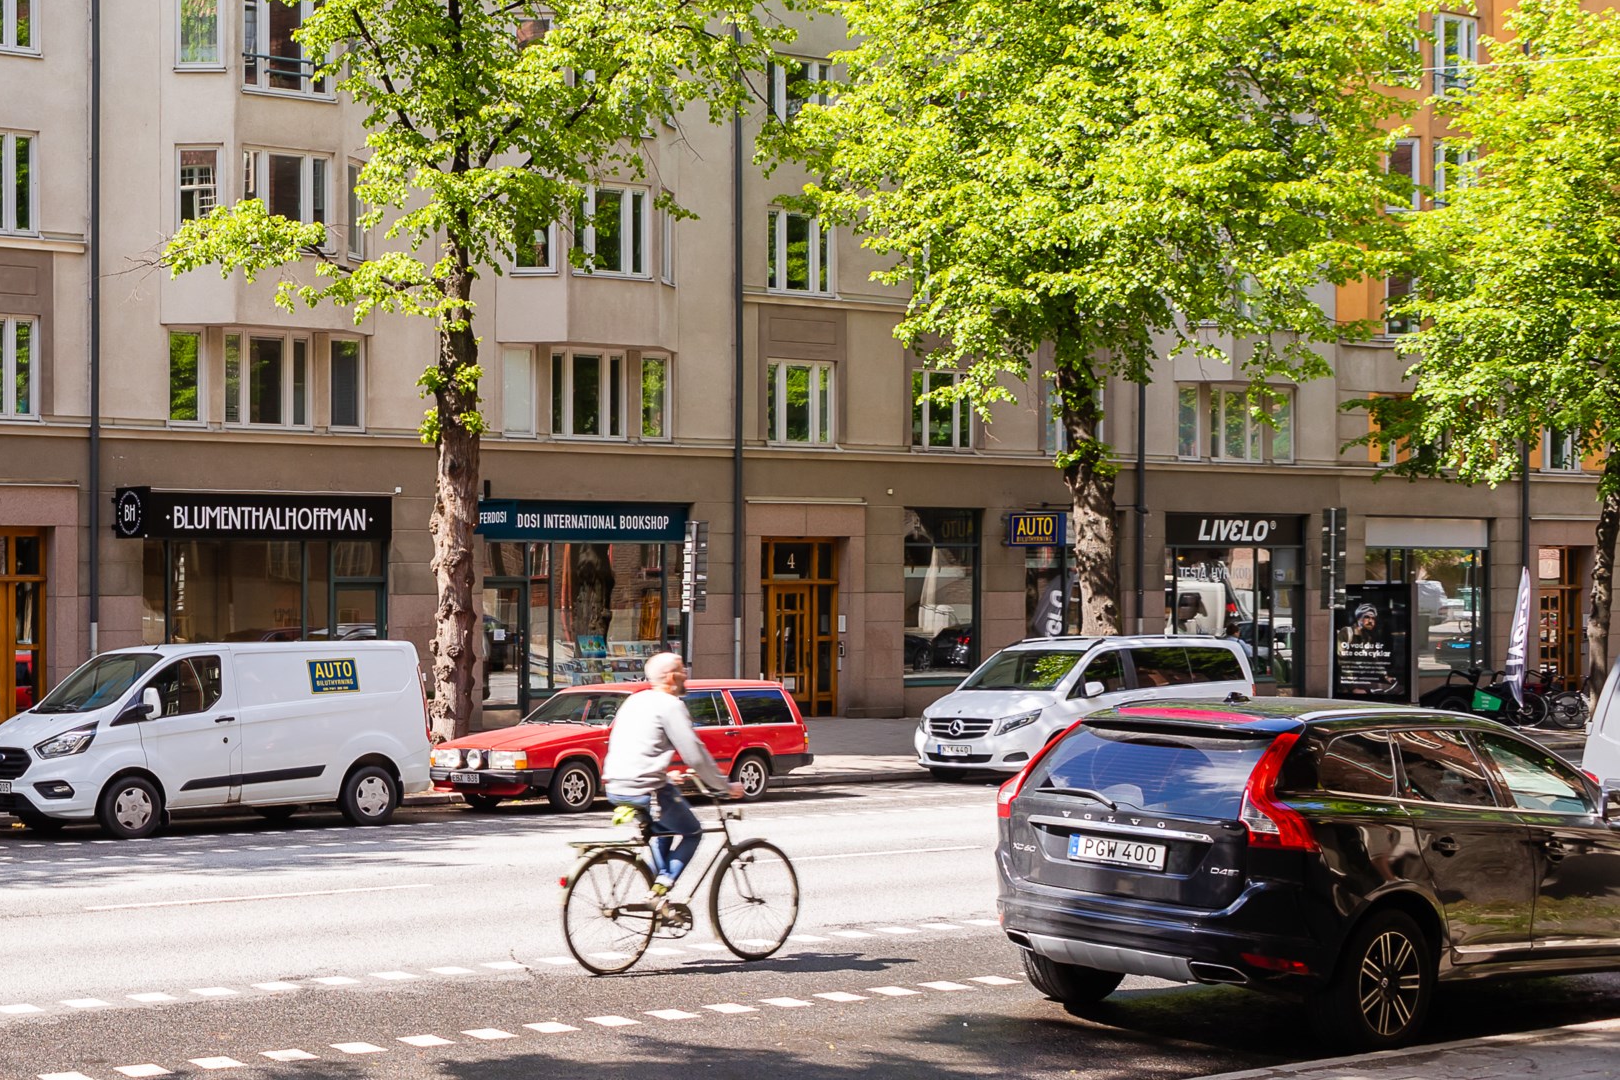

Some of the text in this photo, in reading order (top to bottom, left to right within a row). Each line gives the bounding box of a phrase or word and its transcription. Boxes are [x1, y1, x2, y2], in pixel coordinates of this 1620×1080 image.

[124, 504, 136, 521] BH
[479, 511, 507, 524] FERDOSI
[517, 513, 670, 530] DOSI INTERNATIONAL BOOKSHOP
[1017, 517, 1053, 536] AUTO
[787, 553, 796, 569] 4
[1368, 650, 1391, 658] cyklar
[315, 661, 353, 679] AUTO
[1062, 810, 1165, 828] VOLVO
[1084, 838, 1157, 863] PGW 400
